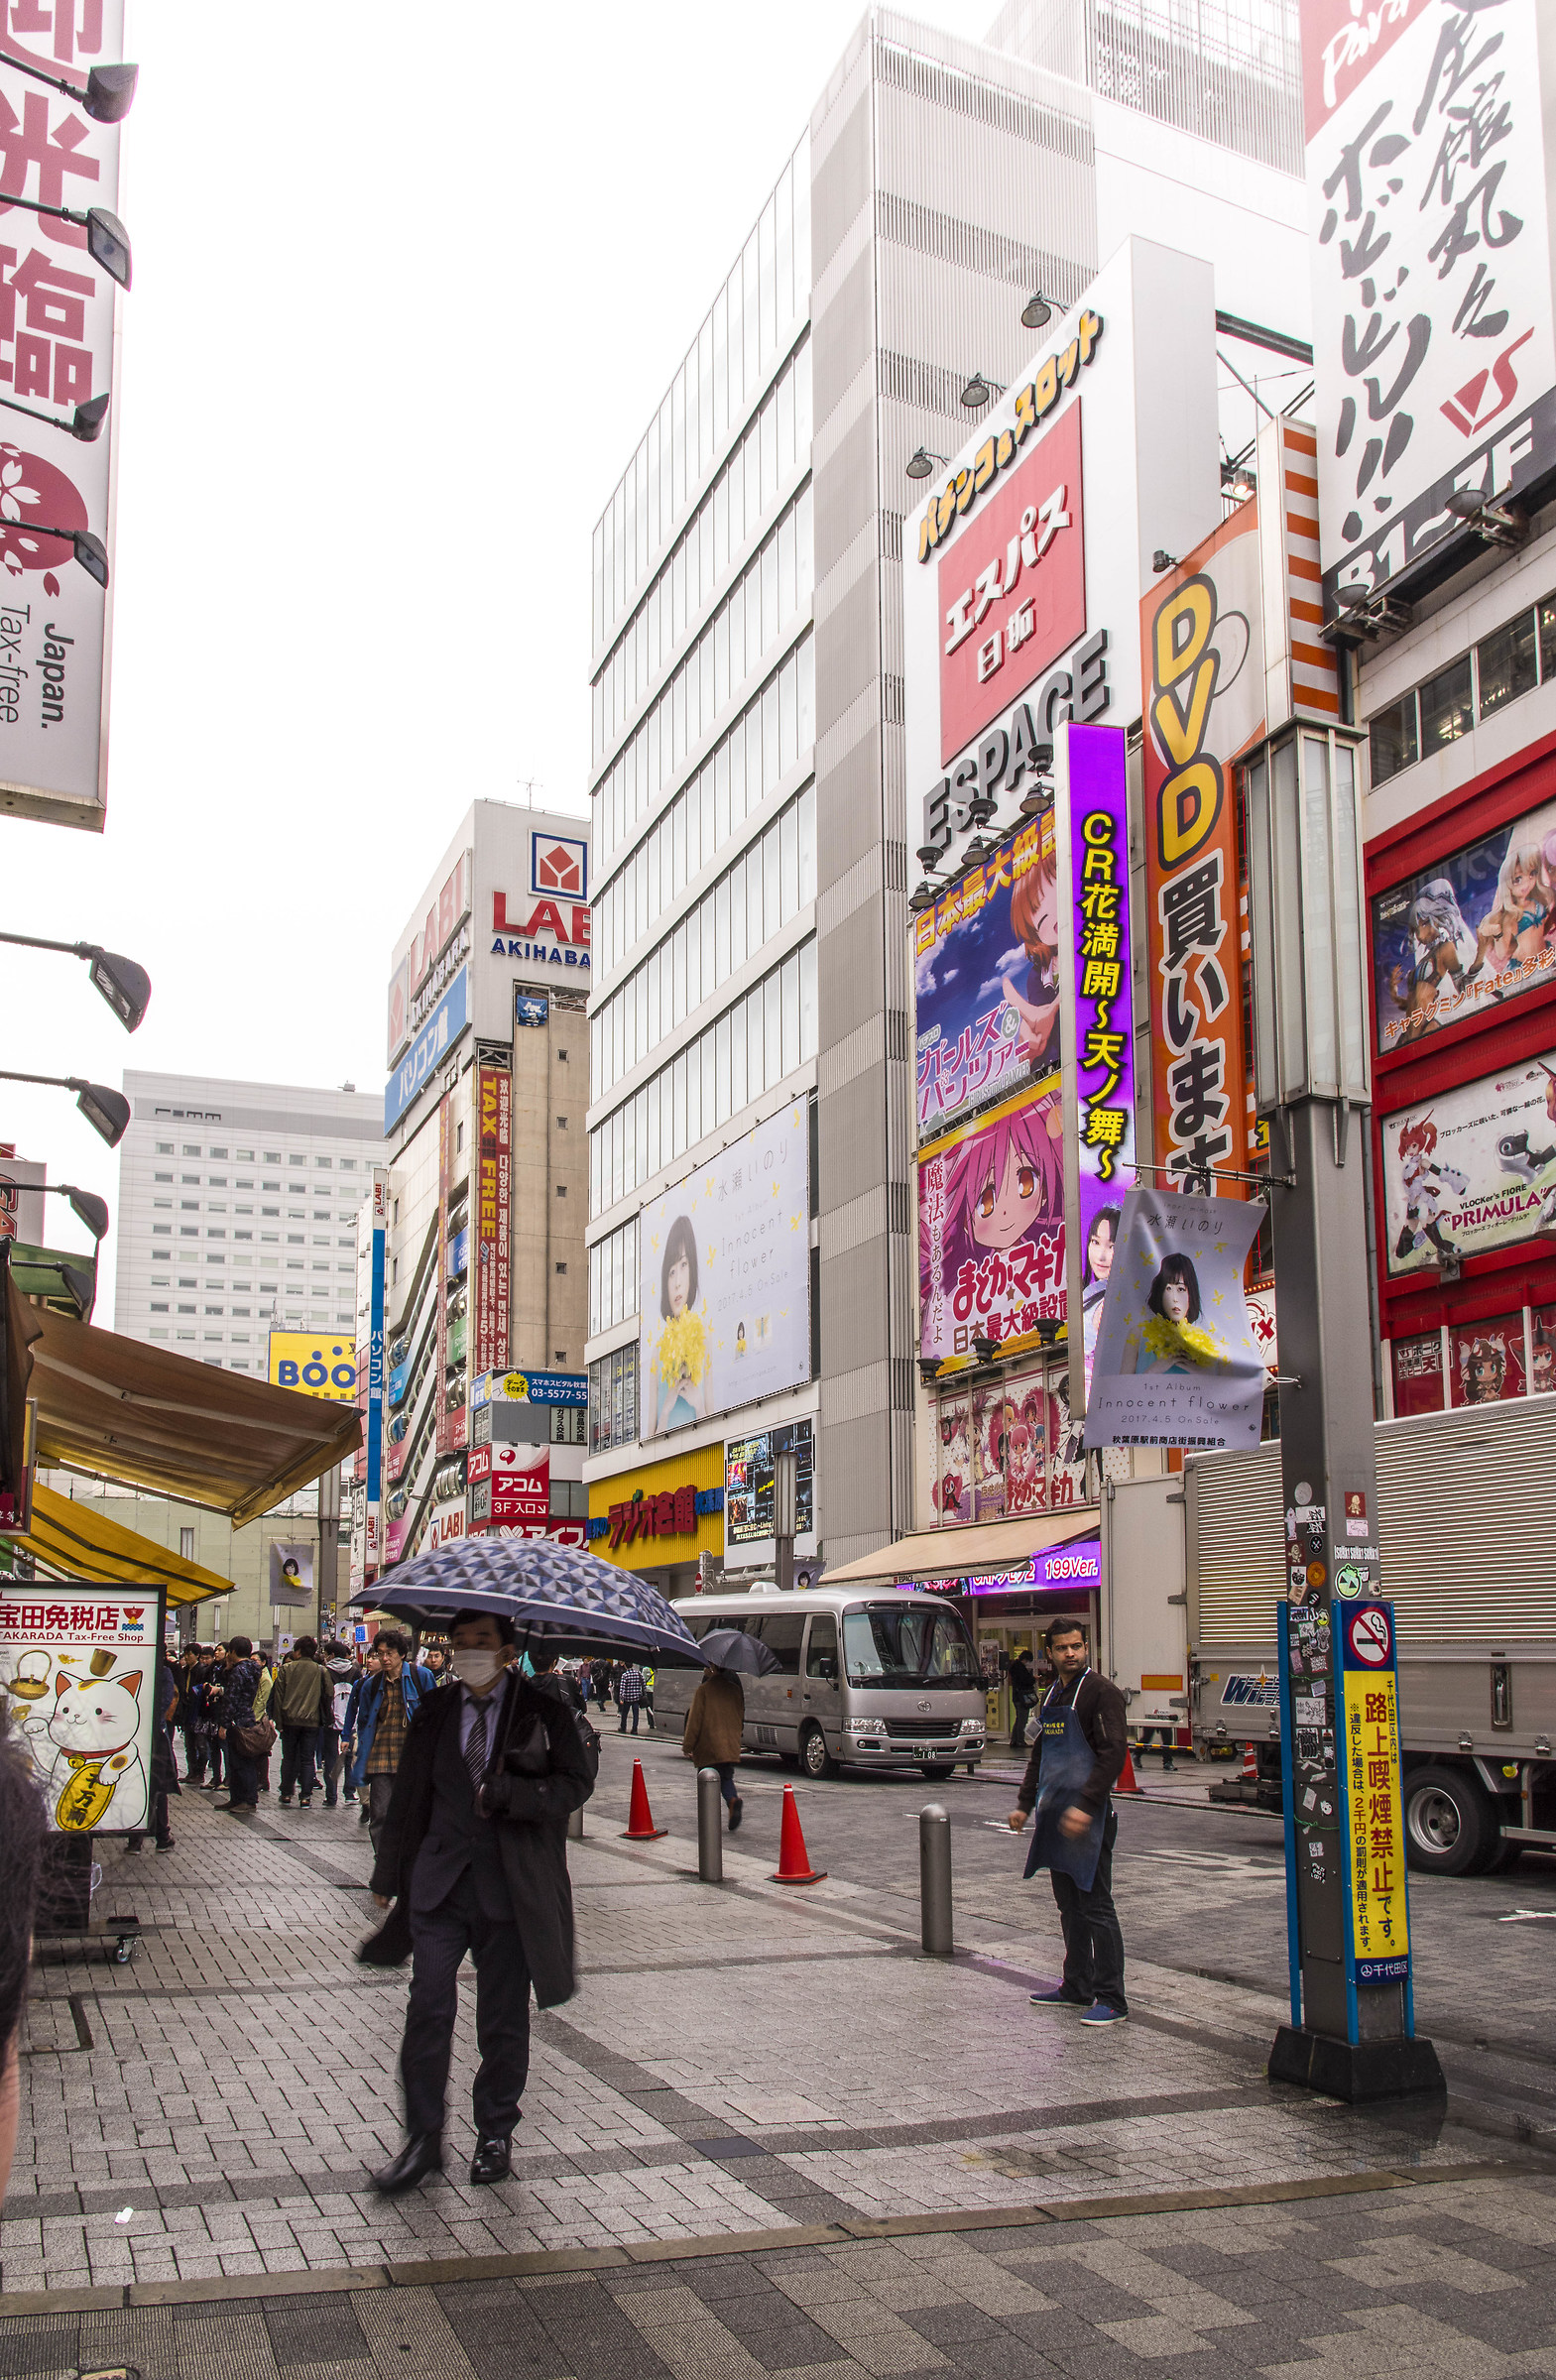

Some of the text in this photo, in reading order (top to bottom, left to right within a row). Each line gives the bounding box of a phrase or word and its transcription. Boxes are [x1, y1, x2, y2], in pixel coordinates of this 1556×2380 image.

[918, 309, 1103, 562] パチンコ&スロット
[945, 484, 1072, 655] エスパス
[977, 598, 1036, 684] 日拓
[41, 621, 75, 732] Japan.
[923, 629, 1111, 853] ESPACE
[411, 852, 466, 1003] LABI
[399, 1005, 448, 1107] パソコン館
[481, 1077, 497, 1238] TAX FREE
[717, 1137, 788, 1202] 水瀬いのり
[1501, 1183, 1527, 1197] FIORE
[1147, 1213, 1223, 1236] 水瀬いのり
[926, 1162, 945, 1344] 魔法もあるんだよ
[370, 1330, 382, 1399] パソコン館
[507, 1378, 526, 1387] データ
[532, 1388, 588, 1400] 03-5577-55
[1166, 1382, 1201, 1391] Album
[1098, 1395, 1250, 1411] Innocent flower
[576, 1409, 585, 1442] 液晶交換
[1195, 1416, 1220, 1426] Sale
[469, 1451, 489, 1480] アコム
[498, 1477, 543, 1493] アコム
[494, 1502, 511, 1513] 3F
[515, 1502, 536, 1514] 入口
[608, 1485, 697, 1549] ラジオ会館
[440, 1511, 463, 1542] LABI
[898, 1575, 913, 1584] ESPACE
[1044, 1556, 1099, 1581] 199Ver.
[67, 1631, 115, 1642] Tax-Free
[117, 1632, 144, 1642] Shop
[1365, 1691, 1395, 1948] 路上喫煙禁止です。
[1374, 1960, 1408, 1977] 千代田区
